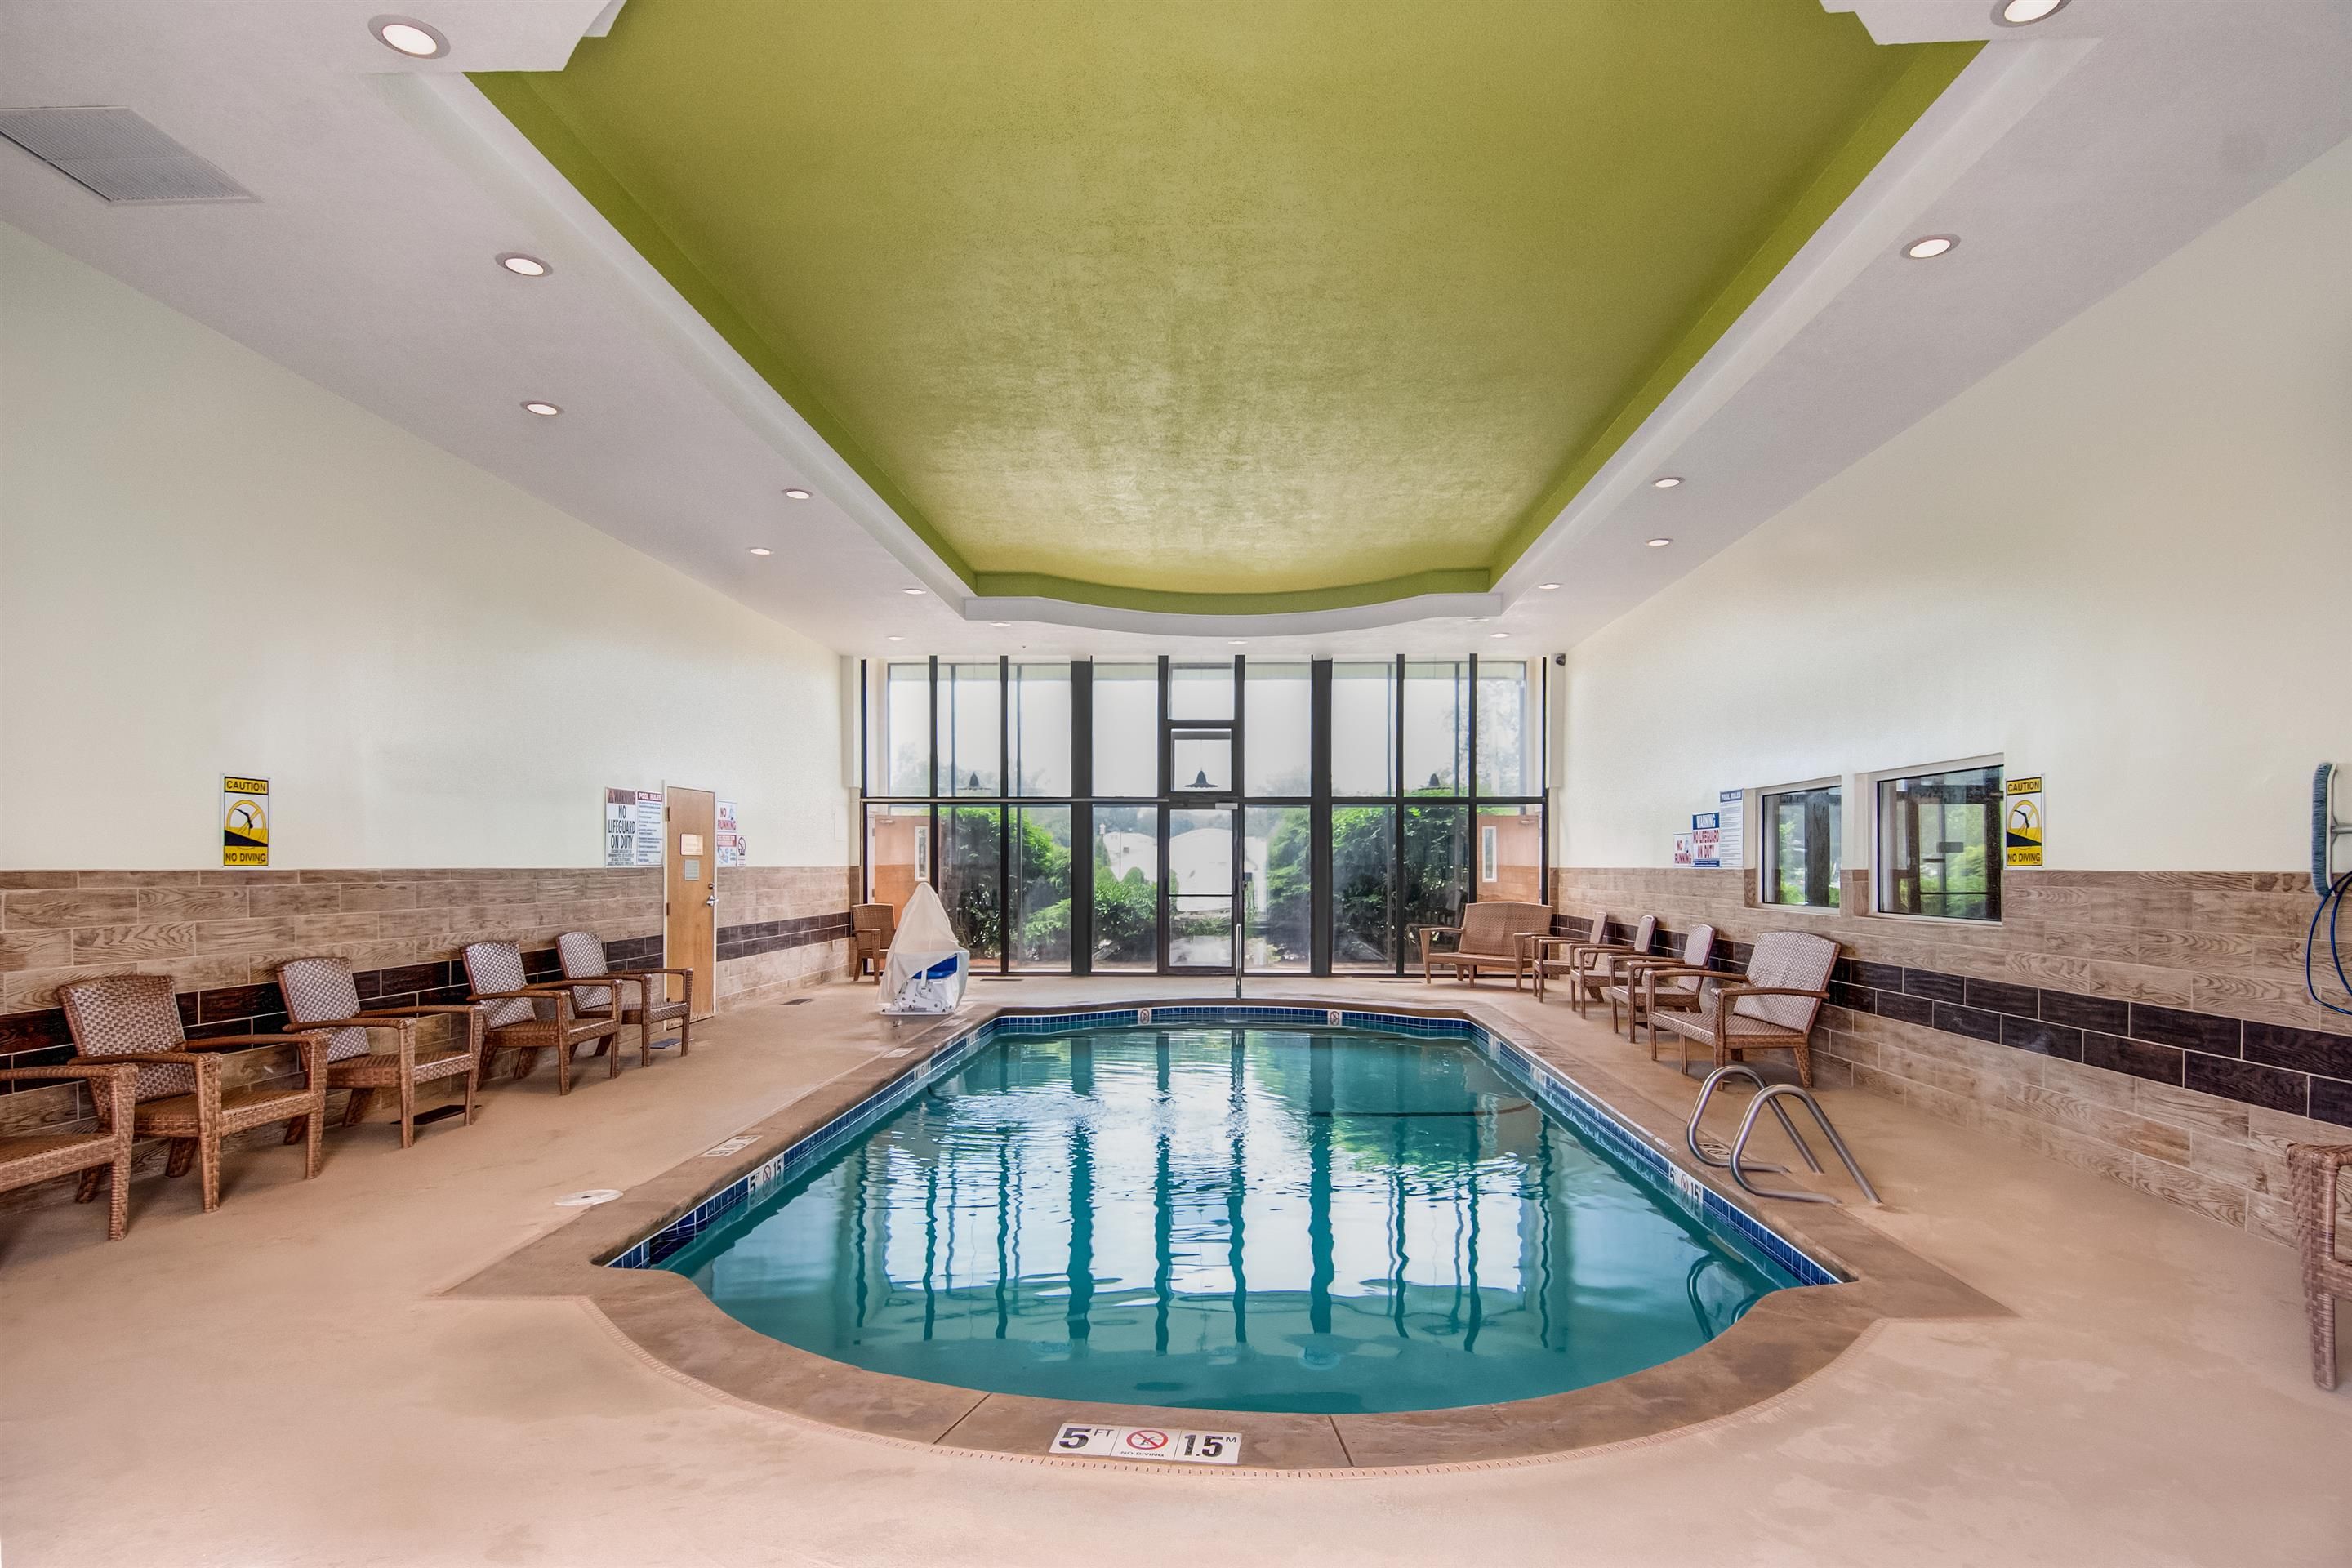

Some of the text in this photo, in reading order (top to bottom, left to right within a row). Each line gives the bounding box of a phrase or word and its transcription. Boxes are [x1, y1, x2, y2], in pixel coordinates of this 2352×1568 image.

[226, 781, 265, 791] CAUTION
[2008, 782, 2039, 792] CAUTION
[618, 805, 626, 819] NO
[720, 807, 727, 817] NO
[608, 819, 636, 834] LIFEGUARD
[718, 819, 737, 830] RUNNING
[1697, 813, 1716, 829] WARNING
[611, 835, 619, 849] ON
[621, 835, 634, 849] DUTY
[1693, 830, 1719, 843] NO LIFEGUARD
[1677, 840, 1682, 850] NO
[225, 853, 265, 862] NO DIVING
[1698, 845, 1714, 858] ON DUTY
[2007, 853, 2040, 862] NO DIVING
[1674, 853, 1692, 864] RUNNING
[1059, 1428, 1114, 1449] 5 FT
[1184, 1434, 1223, 1458] 1.5
